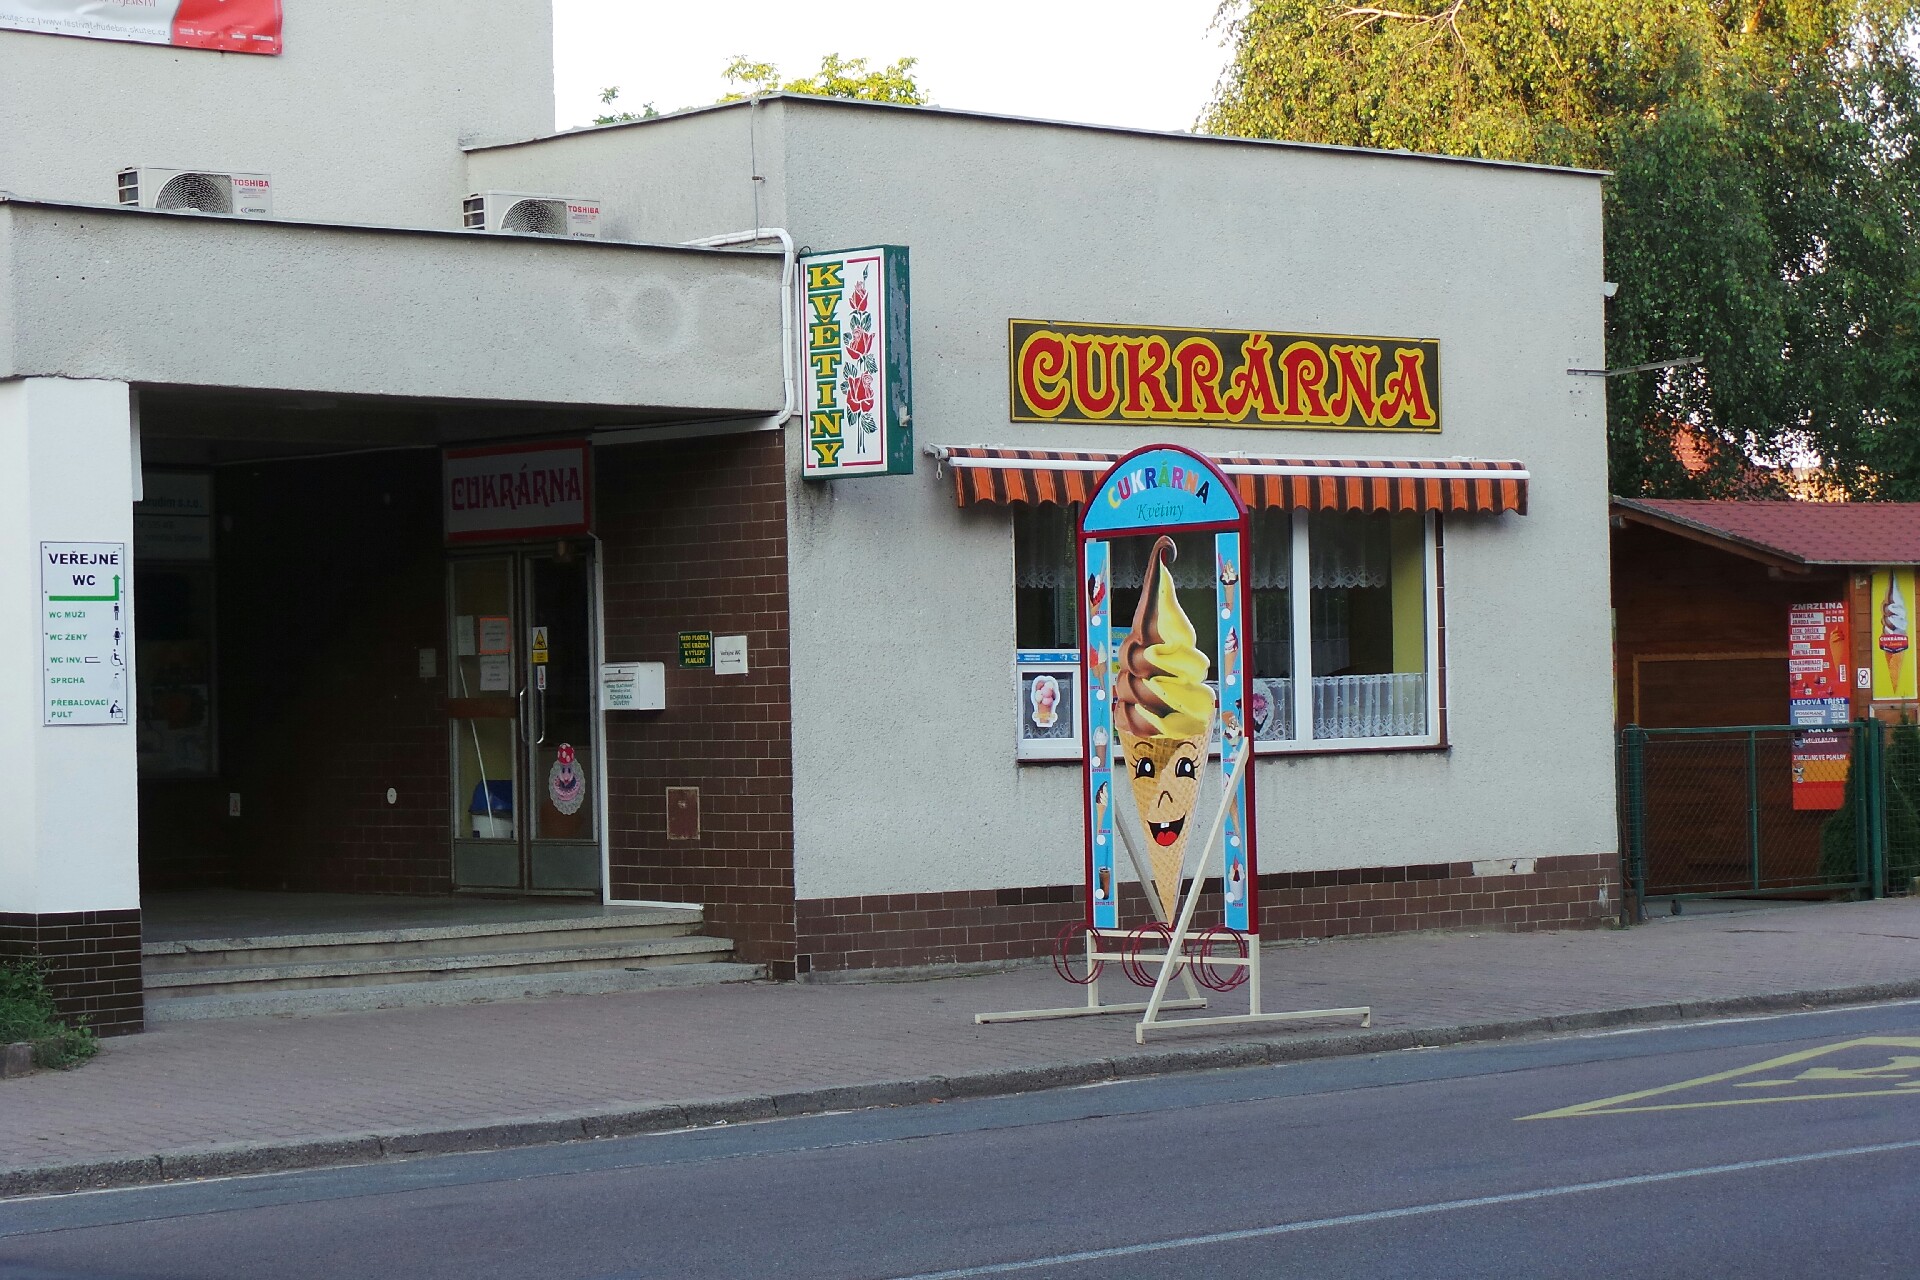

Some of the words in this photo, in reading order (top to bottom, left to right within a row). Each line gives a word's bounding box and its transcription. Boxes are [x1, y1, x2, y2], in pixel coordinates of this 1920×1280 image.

[233, 179, 269, 187] TOSHIBA
[568, 205, 599, 214] TOSHIBA
[808, 262, 844, 466] KVĚTINY
[1019, 331, 1435, 425] CUKRÁRNA
[452, 463, 582, 510] CUKRÁRNA
[1108, 460, 1209, 509] CUKRÁRNA
[1136, 501, 1183, 521] Květiny
[48, 551, 118, 565] VEŘEJNÉ
[72, 575, 96, 586] WC
[1792, 602, 1843, 610] ZMRZLINA
[64, 610, 86, 618] MUŽI
[65, 632, 88, 641] ŽENY
[51, 698, 109, 706] PŘEBALOVACÍ
